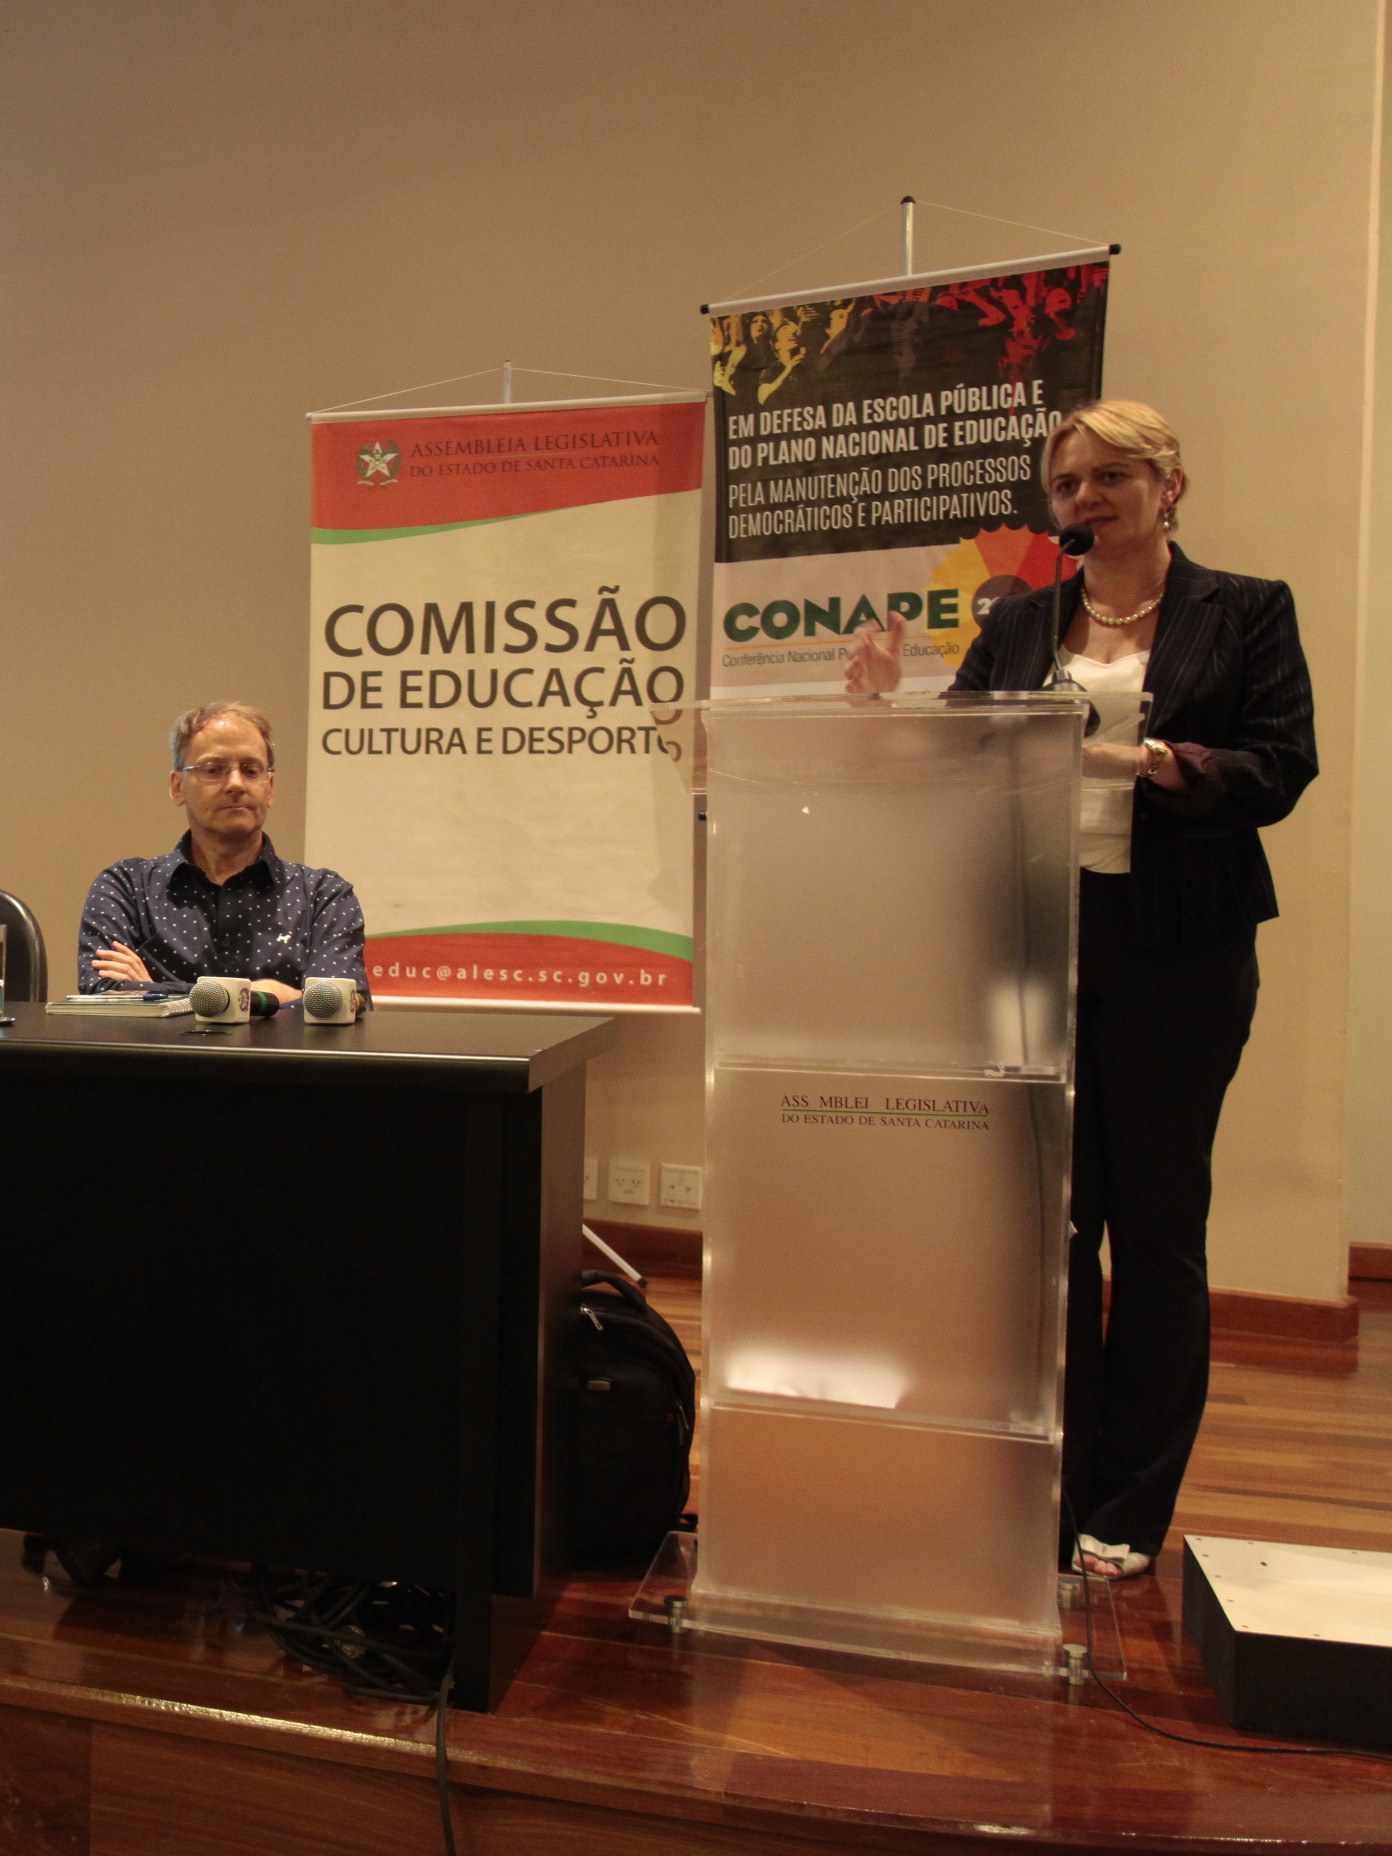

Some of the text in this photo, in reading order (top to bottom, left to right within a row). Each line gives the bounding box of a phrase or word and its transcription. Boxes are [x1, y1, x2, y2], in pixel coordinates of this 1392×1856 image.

[728, 379, 1044, 440] EM DEFESA DA ESCOLA PÚBLICA E
[410, 429, 659, 458] ASSEMBLEIA LEGISLATIVA
[728, 406, 1062, 470] DO PLANO NACIONAL DE EDUCAÇÃO
[409, 452, 660, 478] DO ESTADO DE SANTA CATARINA
[728, 454, 1032, 509] PELA MANUTENÇÃO DOS PROCESSOS
[728, 489, 1018, 539] DEMOCRÁTICOS E PARTICIPATIVOS.
[323, 584, 687, 658] COMISSÃO
[723, 588, 960, 643] CONAPE
[722, 649, 786, 669] Conferência
[787, 648, 829, 665] Nacional
[902, 642, 959, 659] Educação
[322, 657, 685, 722] DE EDUCAÇÃO
[321, 726, 468, 756] CULTURA
[476, 727, 494, 755] E
[372, 962, 668, 987] educ@alesc.sc.gov.br
[781, 1113, 990, 1131] DO ESTADO DE SANTA CATARINA
[884, 1096, 990, 1115] LEGISLATIVA
